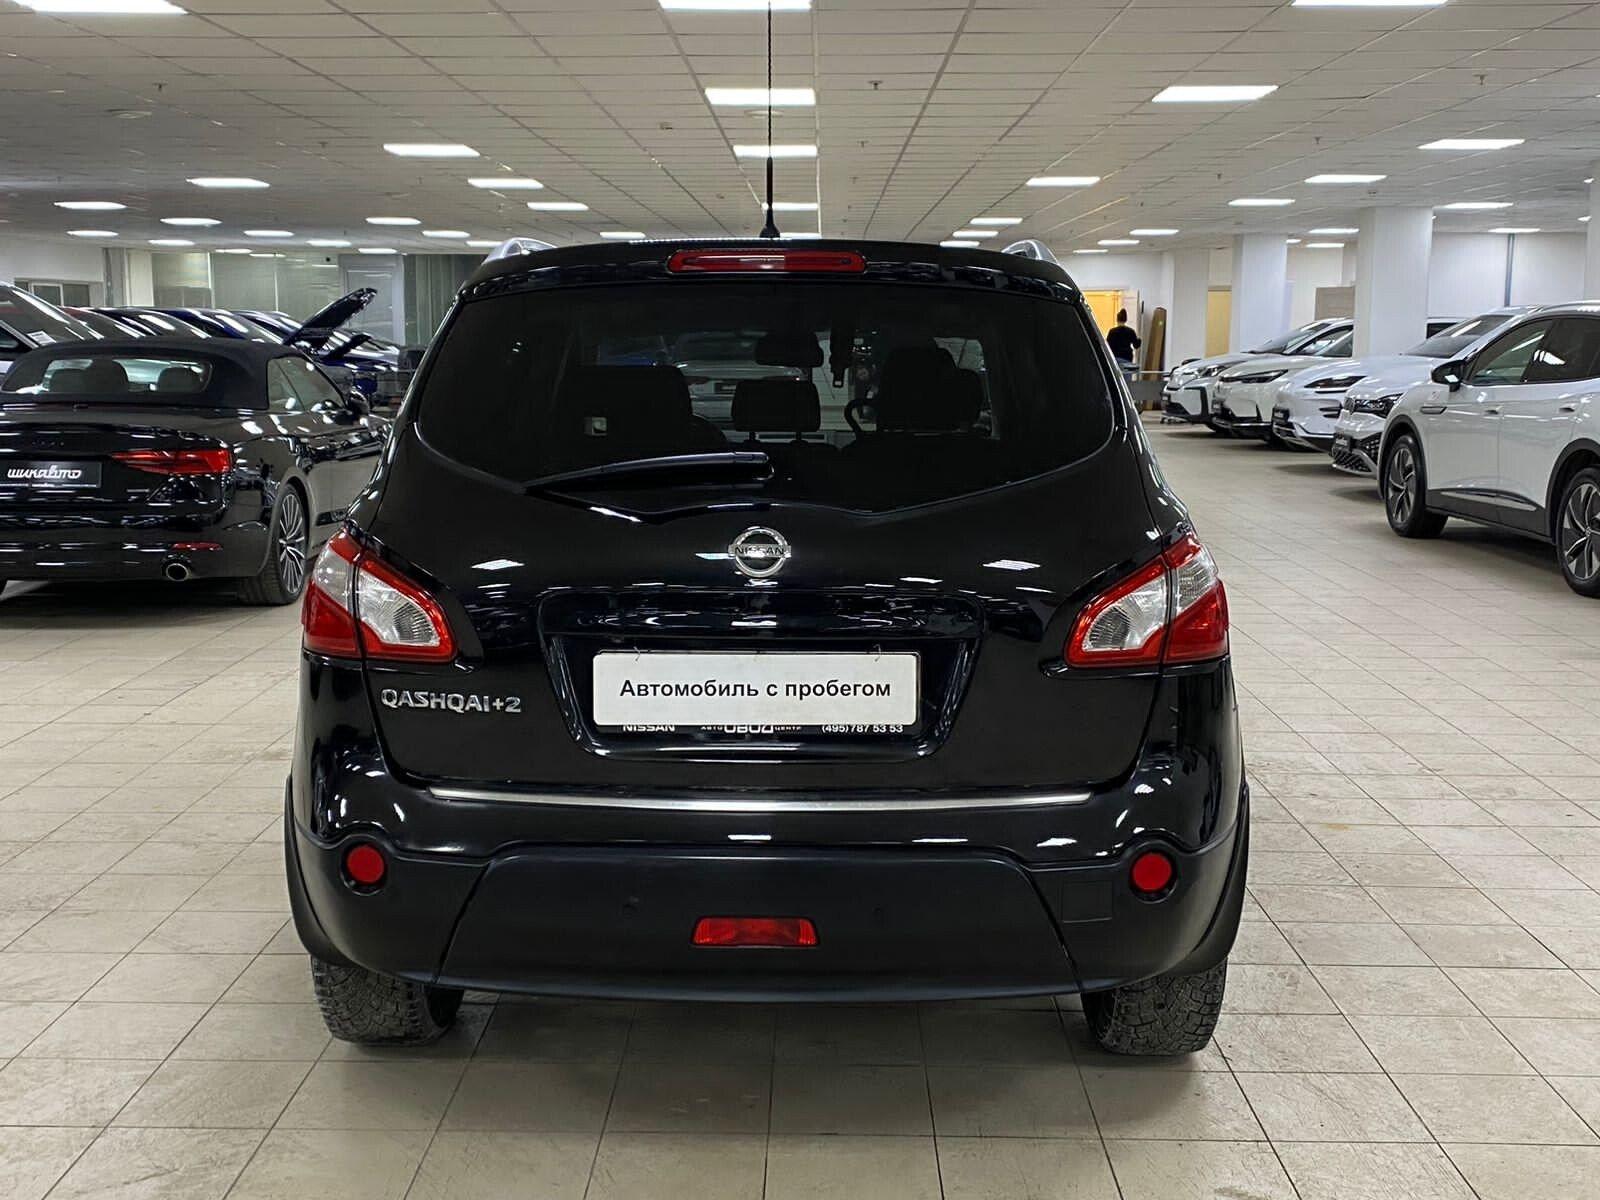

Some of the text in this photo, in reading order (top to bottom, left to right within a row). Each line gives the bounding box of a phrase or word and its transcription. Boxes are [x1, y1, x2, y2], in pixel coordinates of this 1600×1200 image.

[735, 546, 784, 555] NISSAN
[620, 679, 891, 701] Автомобиль с пробегом
[622, 724, 676, 732] NISSAN
